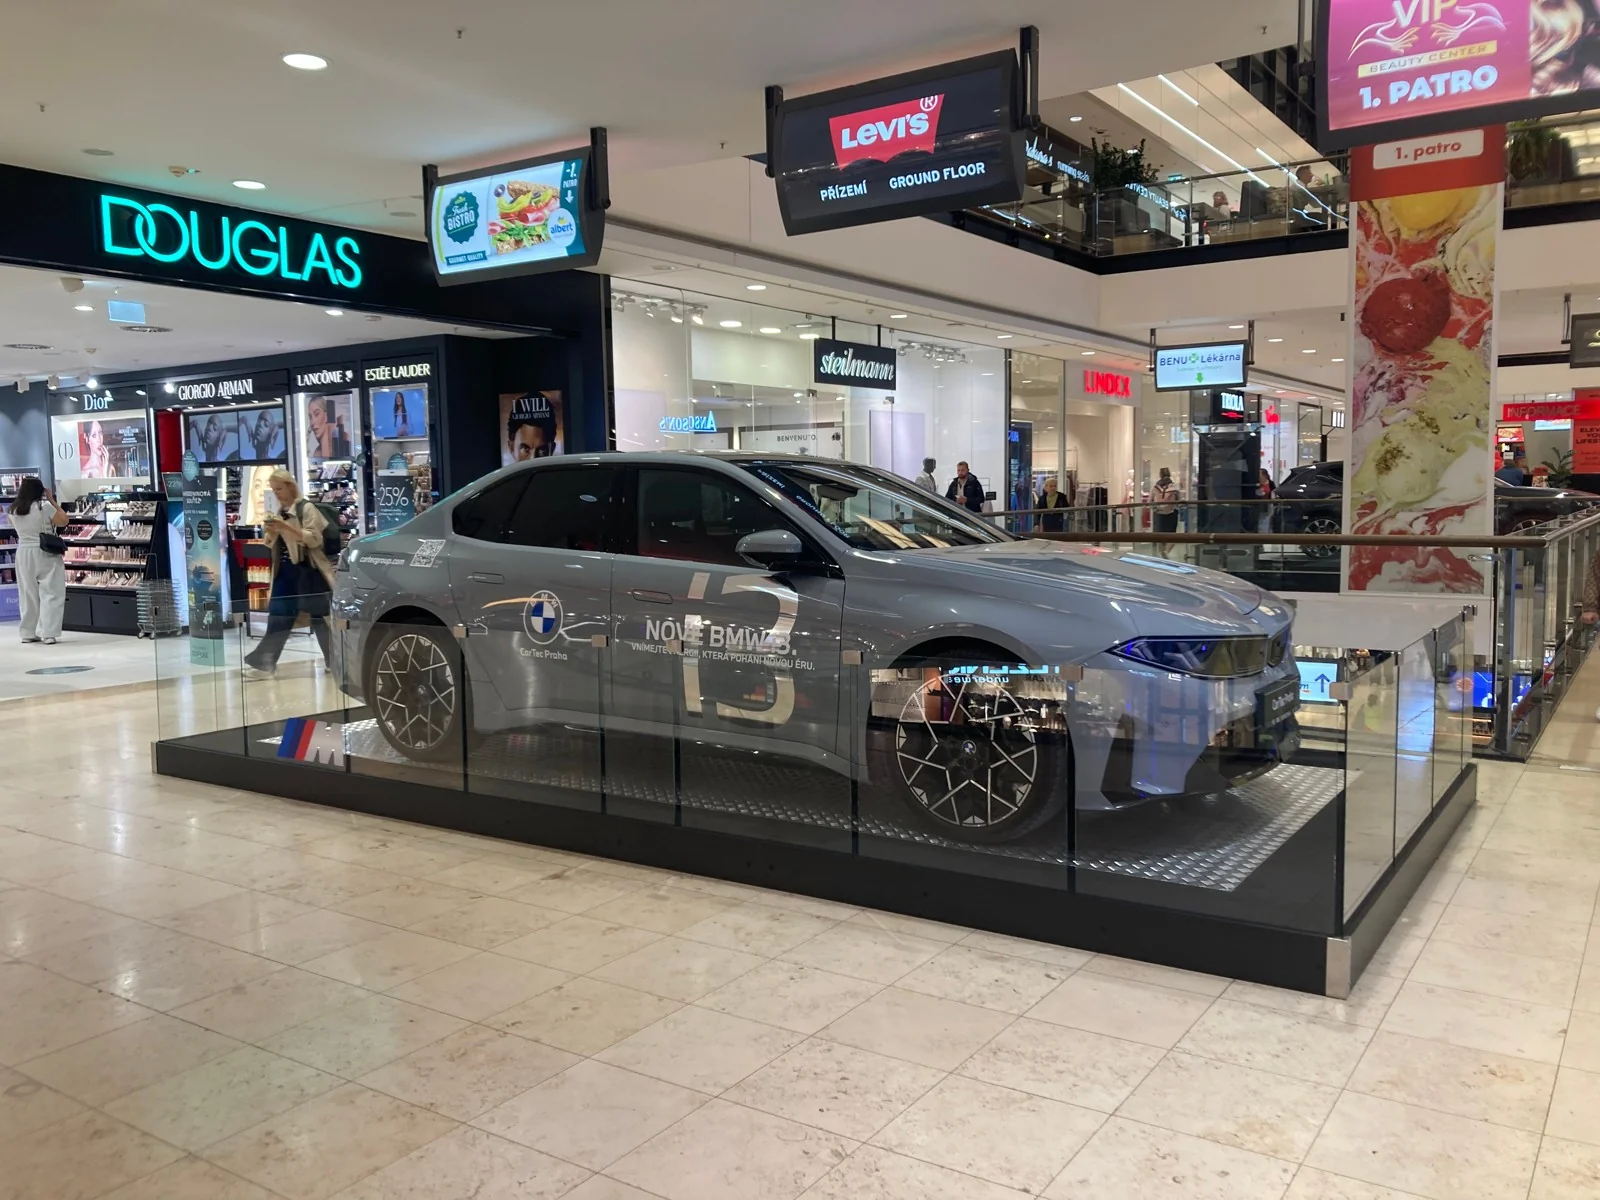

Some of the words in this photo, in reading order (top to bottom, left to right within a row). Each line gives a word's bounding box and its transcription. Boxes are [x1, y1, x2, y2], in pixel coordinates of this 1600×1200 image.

[1370, 55, 1424, 73] BEAUTY
[1429, 44, 1487, 61] CENTER
[1359, 86, 1382, 110] 1.
[1389, 65, 1498, 106] PATRO
[1396, 145, 1409, 160] 1.
[1413, 139, 1462, 161] patro
[563, 179, 578, 188] PATRO
[820, 180, 868, 202] PŘÍZEMÍ
[889, 169, 940, 189] GROUND
[943, 161, 986, 181] FLOOR
[447, 210, 475, 230] BISTRO
[550, 222, 573, 234] albert
[101, 194, 362, 288] DOUGLAS
[820, 348, 894, 380] steilmann
[1160, 355, 1188, 366] BENU
[1200, 353, 1241, 364] Lékárna
[297, 370, 343, 387] LANCÔME
[393, 363, 431, 379] LAUDER
[178, 383, 216, 401] GIORGIO
[217, 378, 254, 398] ARMANI
[1084, 370, 1131, 398] LINDEX
[84, 393, 110, 411] Dior
[520, 397, 550, 413] WILL
[1507, 405, 1580, 418] INFORMACE
[709, 625, 768, 653] BMW
[519, 647, 543, 658] CarTec
[544, 649, 568, 660] Praha
